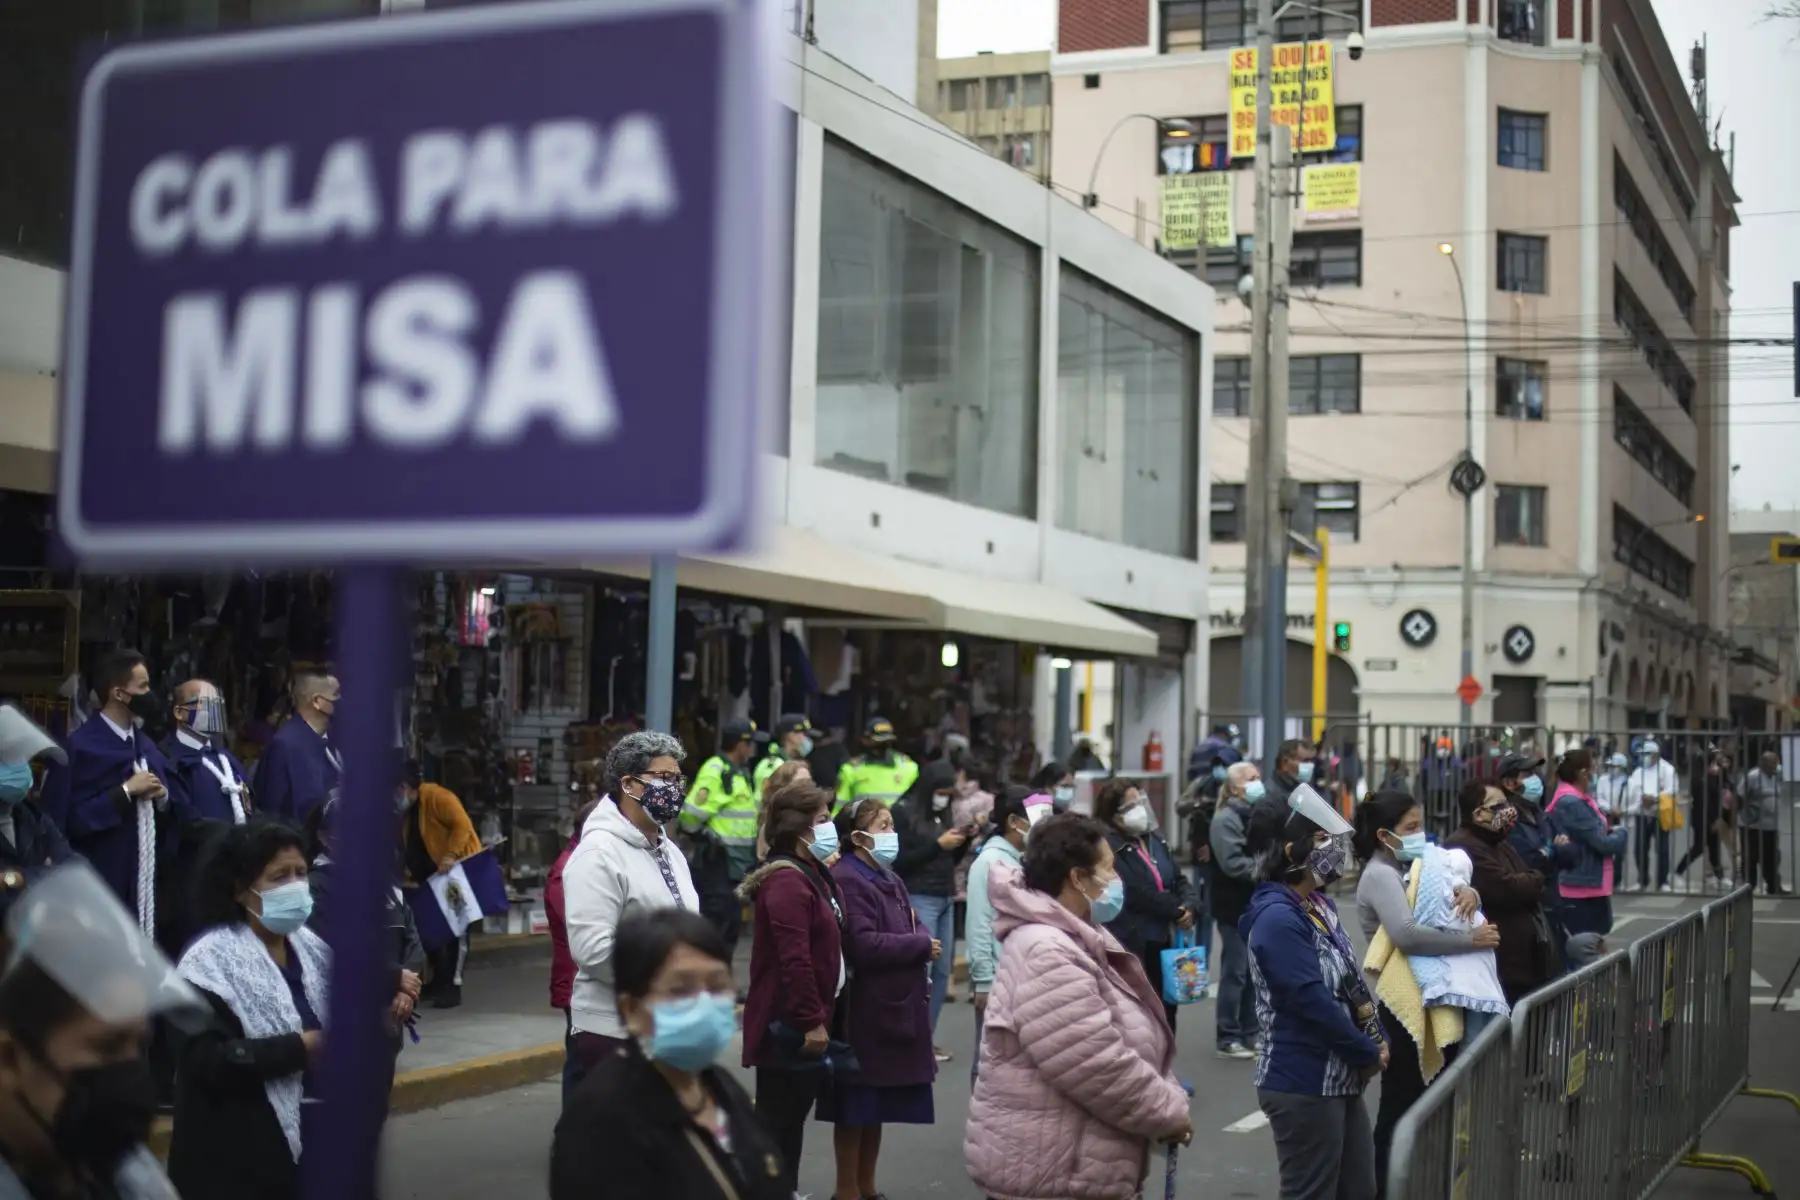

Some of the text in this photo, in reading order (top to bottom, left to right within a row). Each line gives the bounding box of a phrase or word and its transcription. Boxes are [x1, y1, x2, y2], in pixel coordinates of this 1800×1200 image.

[1234, 44, 1327, 70] SE QUILA
[130, 112, 679, 256] COLA PARA
[156, 269, 620, 454] MISA
